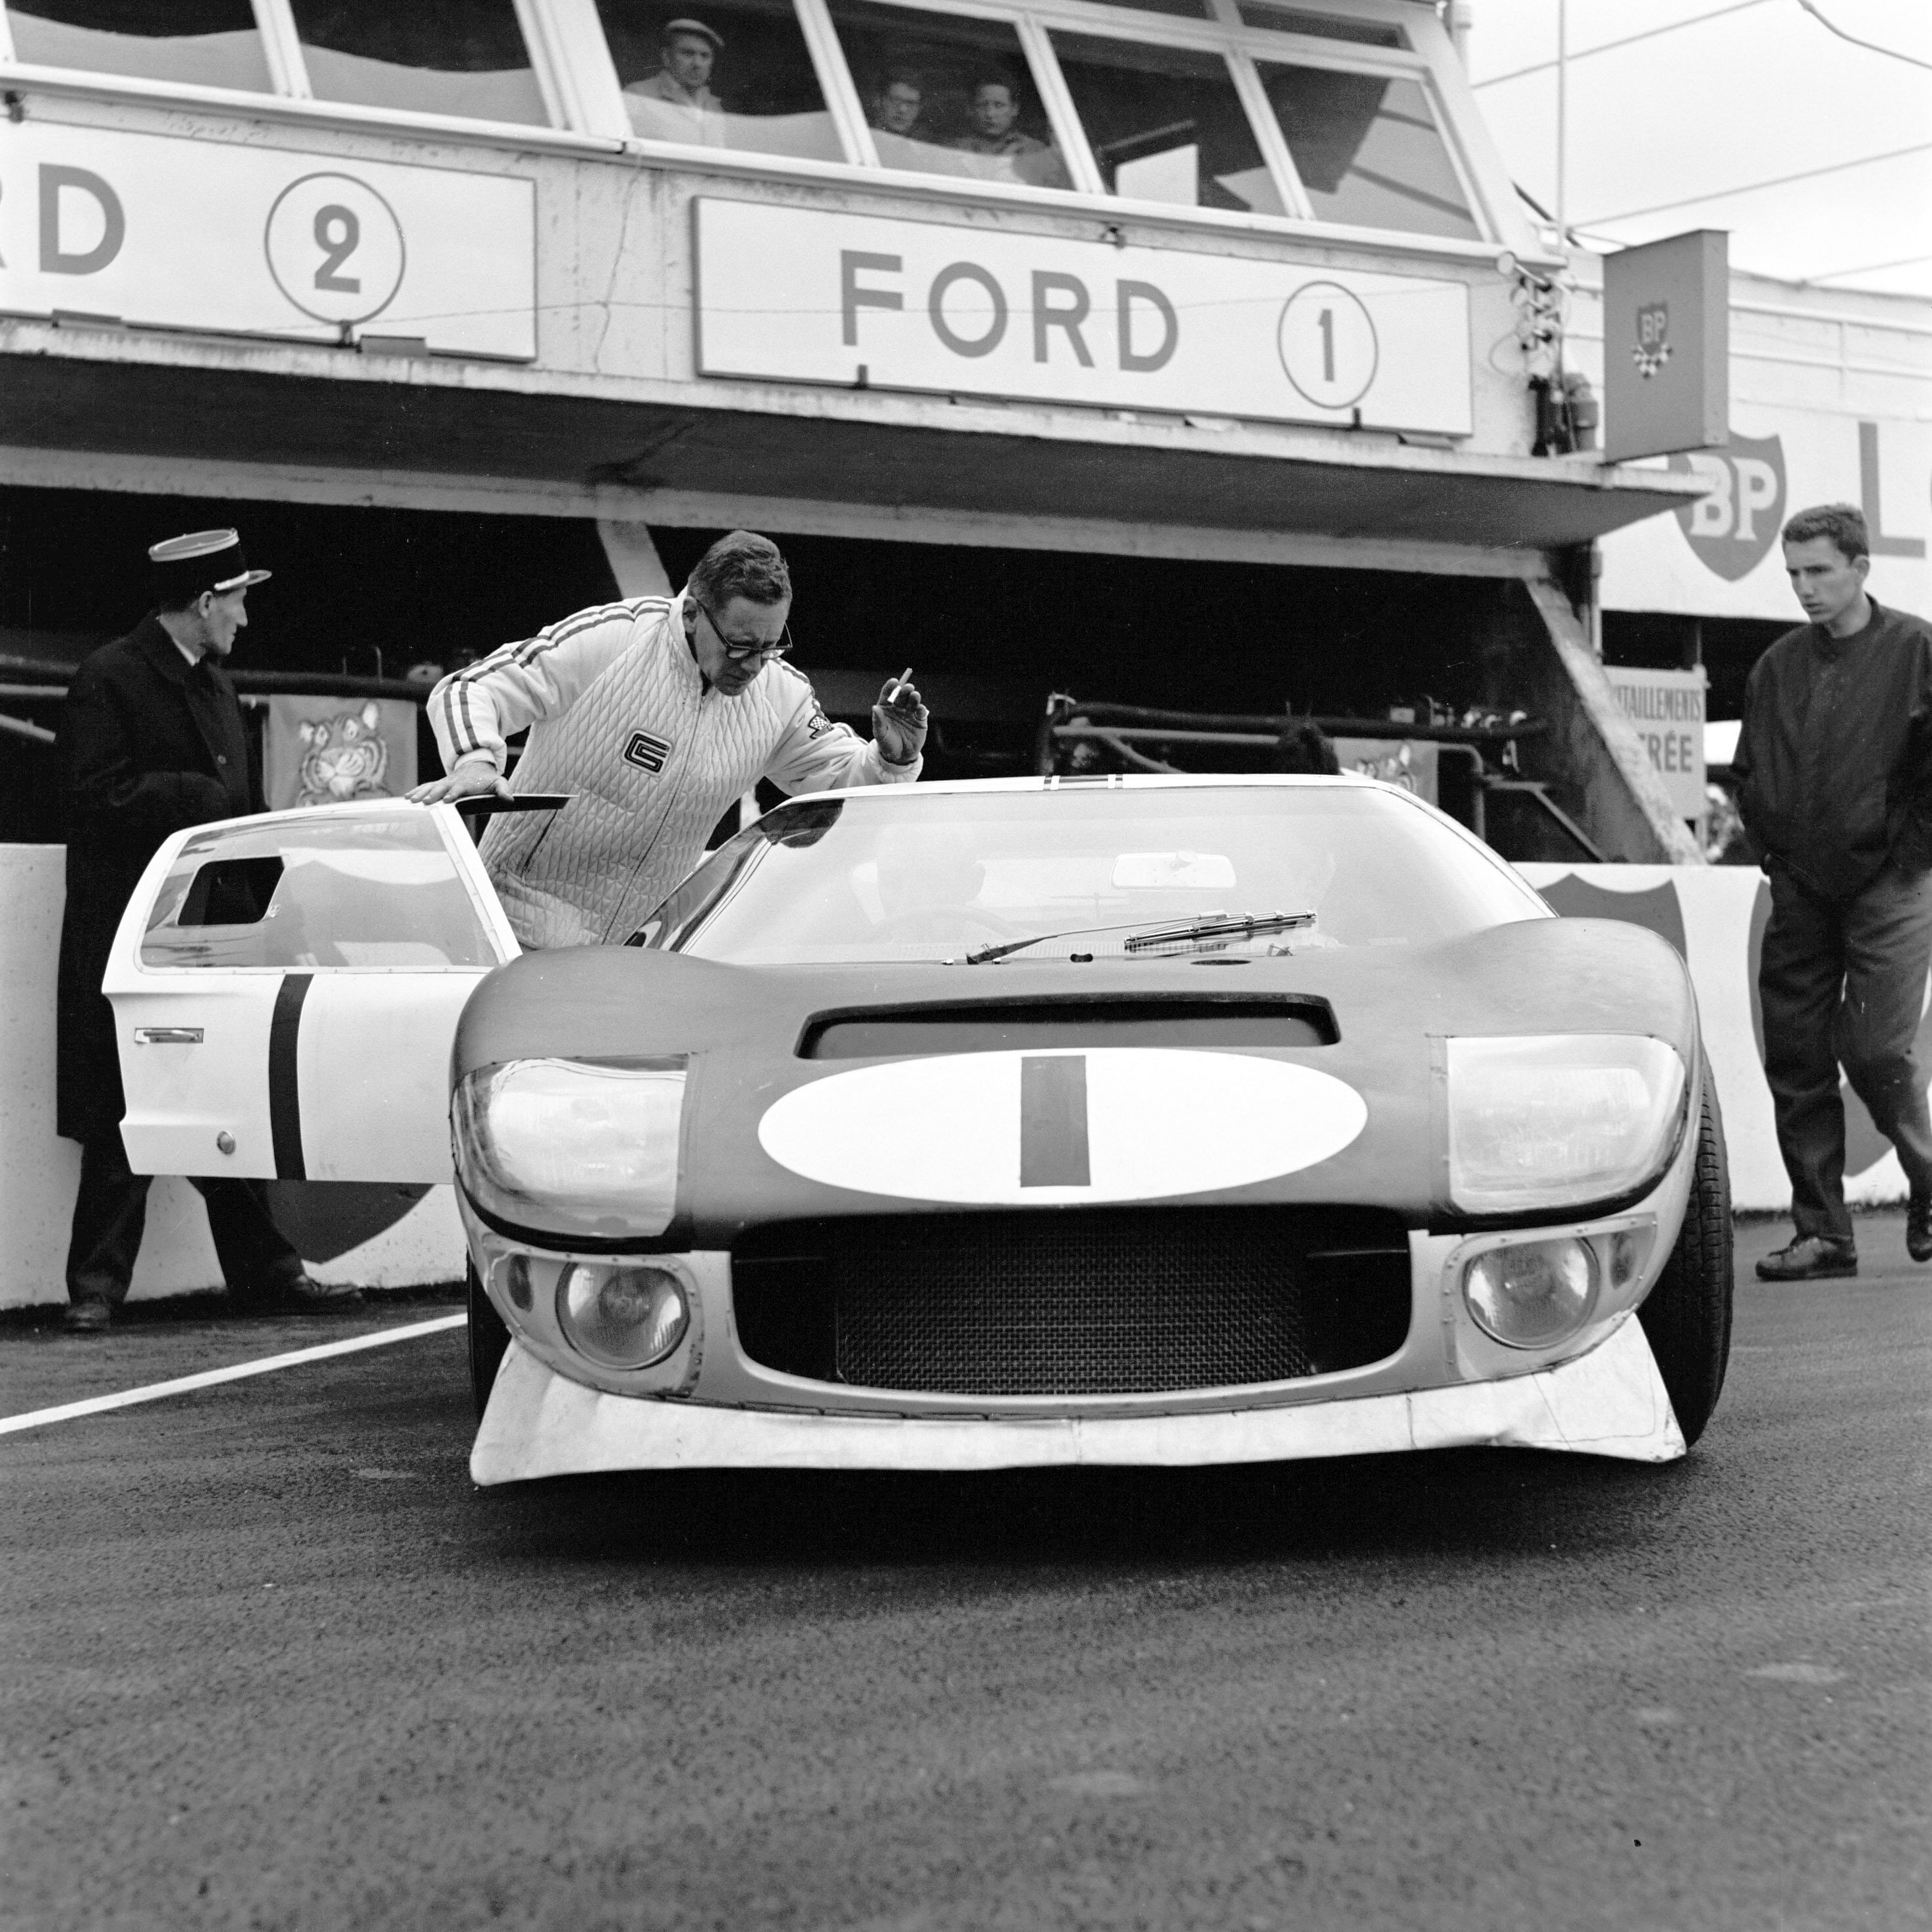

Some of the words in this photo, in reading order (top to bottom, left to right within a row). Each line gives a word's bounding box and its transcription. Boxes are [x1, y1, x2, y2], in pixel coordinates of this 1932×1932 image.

[0, 162, 125, 275] D
[314, 204, 360, 294] 2
[840, 249, 1178, 373] FORD
[1319, 308, 1334, 382] 1
[1641, 310, 1665, 343] BP
[1688, 453, 1778, 540] BP
[1638, 729, 1692, 773] RÉE
[1021, 1055, 1091, 1188] 1
